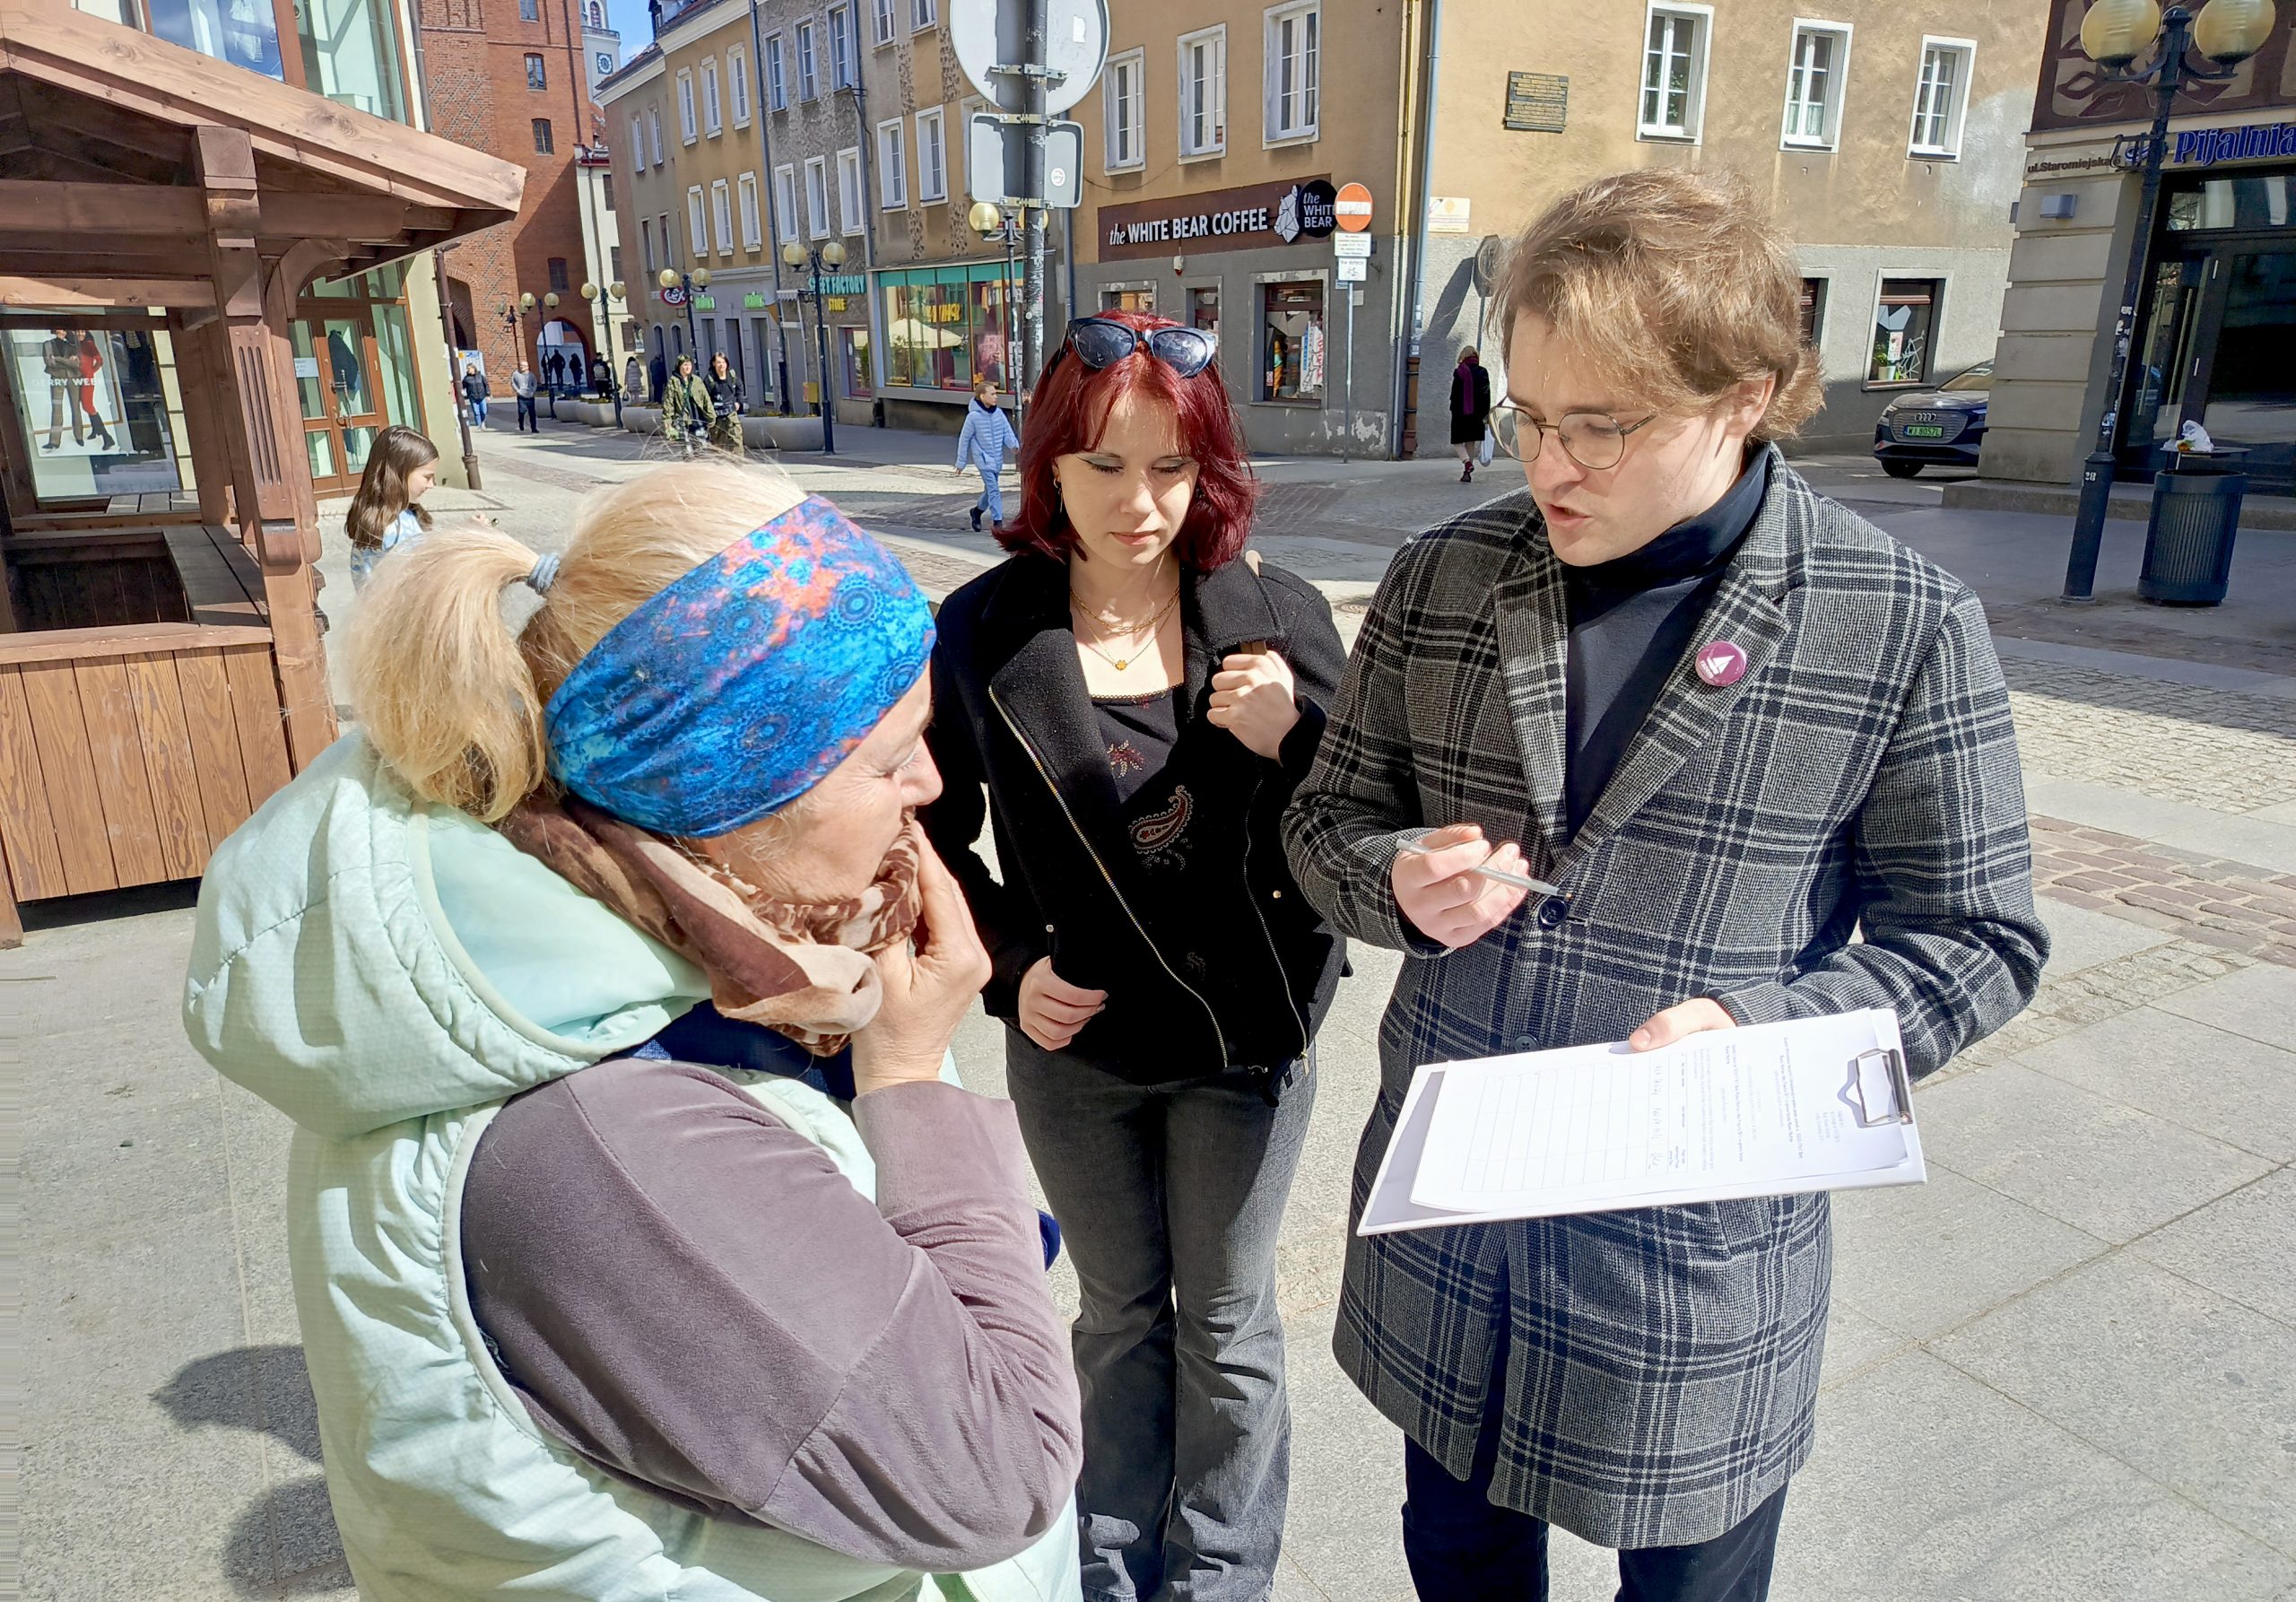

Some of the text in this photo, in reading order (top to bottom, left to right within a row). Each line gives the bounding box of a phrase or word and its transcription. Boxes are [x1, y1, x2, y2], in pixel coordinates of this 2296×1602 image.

[2174, 123, 2296, 166] Pijalnia
[1303, 192, 1320, 205] the
[1109, 207, 1267, 246] the WHITE BEAR COFFEE
[1304, 216, 1333, 228] BEAR
[72, 378, 100, 387] WEB
